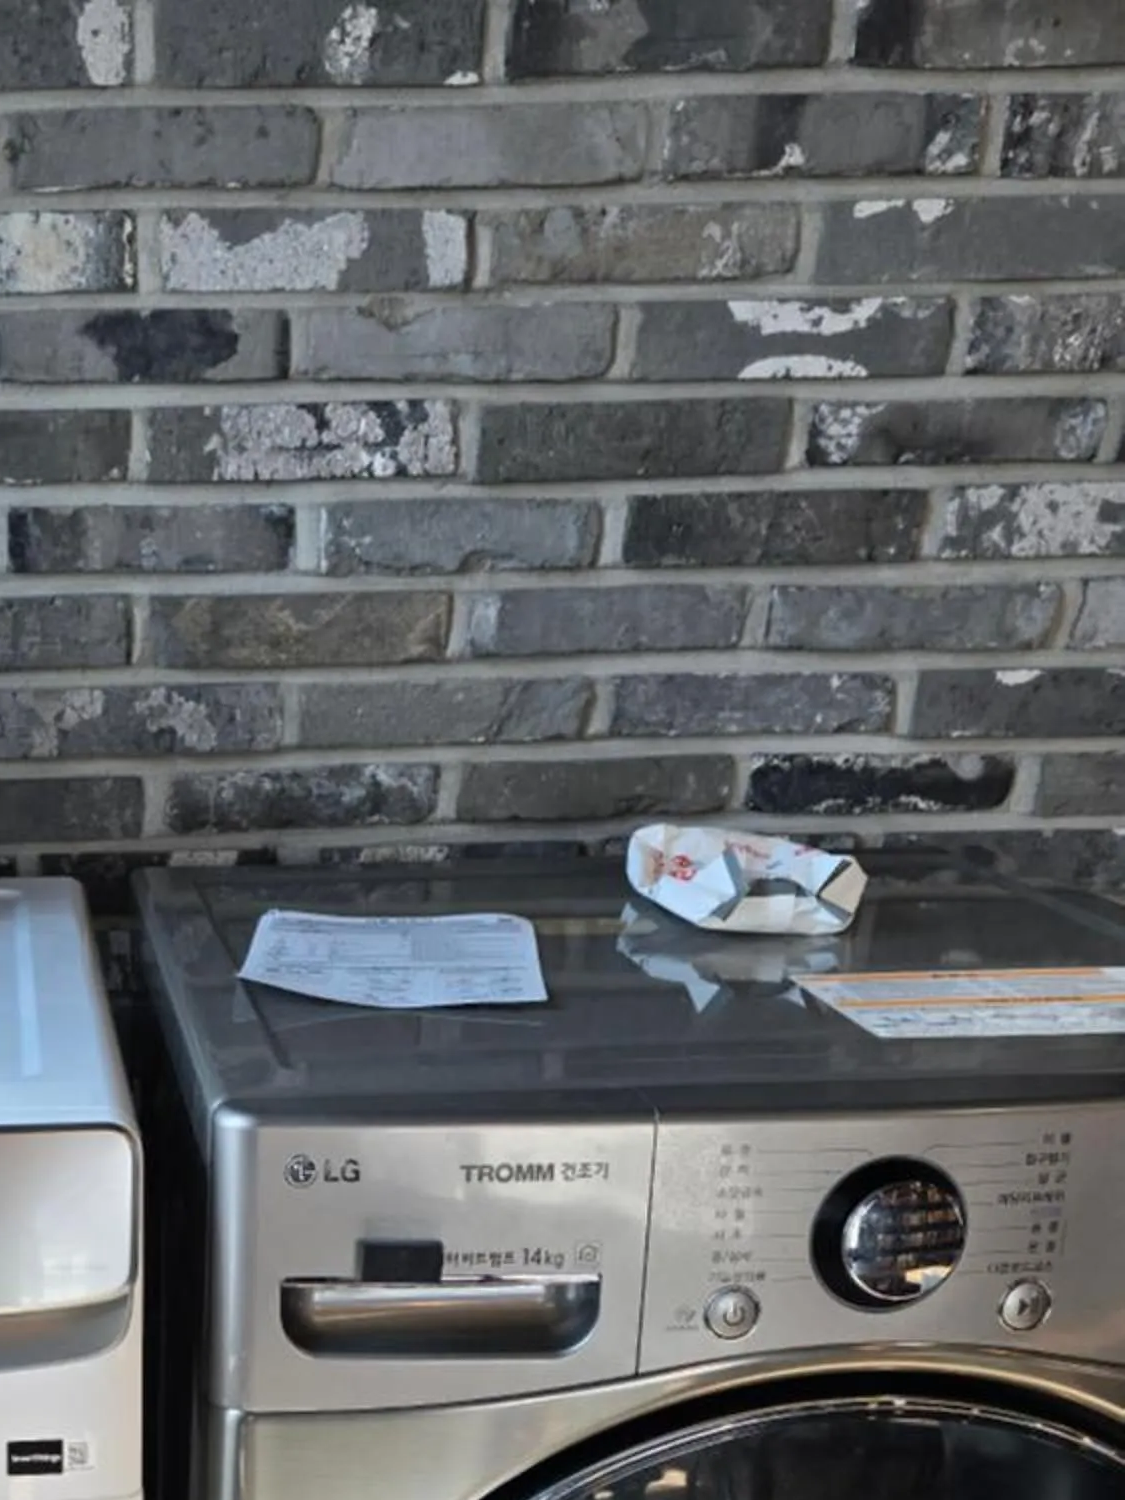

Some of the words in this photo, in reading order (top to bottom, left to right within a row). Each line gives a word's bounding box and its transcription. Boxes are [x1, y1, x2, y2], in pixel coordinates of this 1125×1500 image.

[323, 1158, 361, 1183] LG
[459, 1162, 555, 1183] TROMM
[561, 1161, 610, 1182] 건조기
[523, 1247, 566, 1270] 14kg
